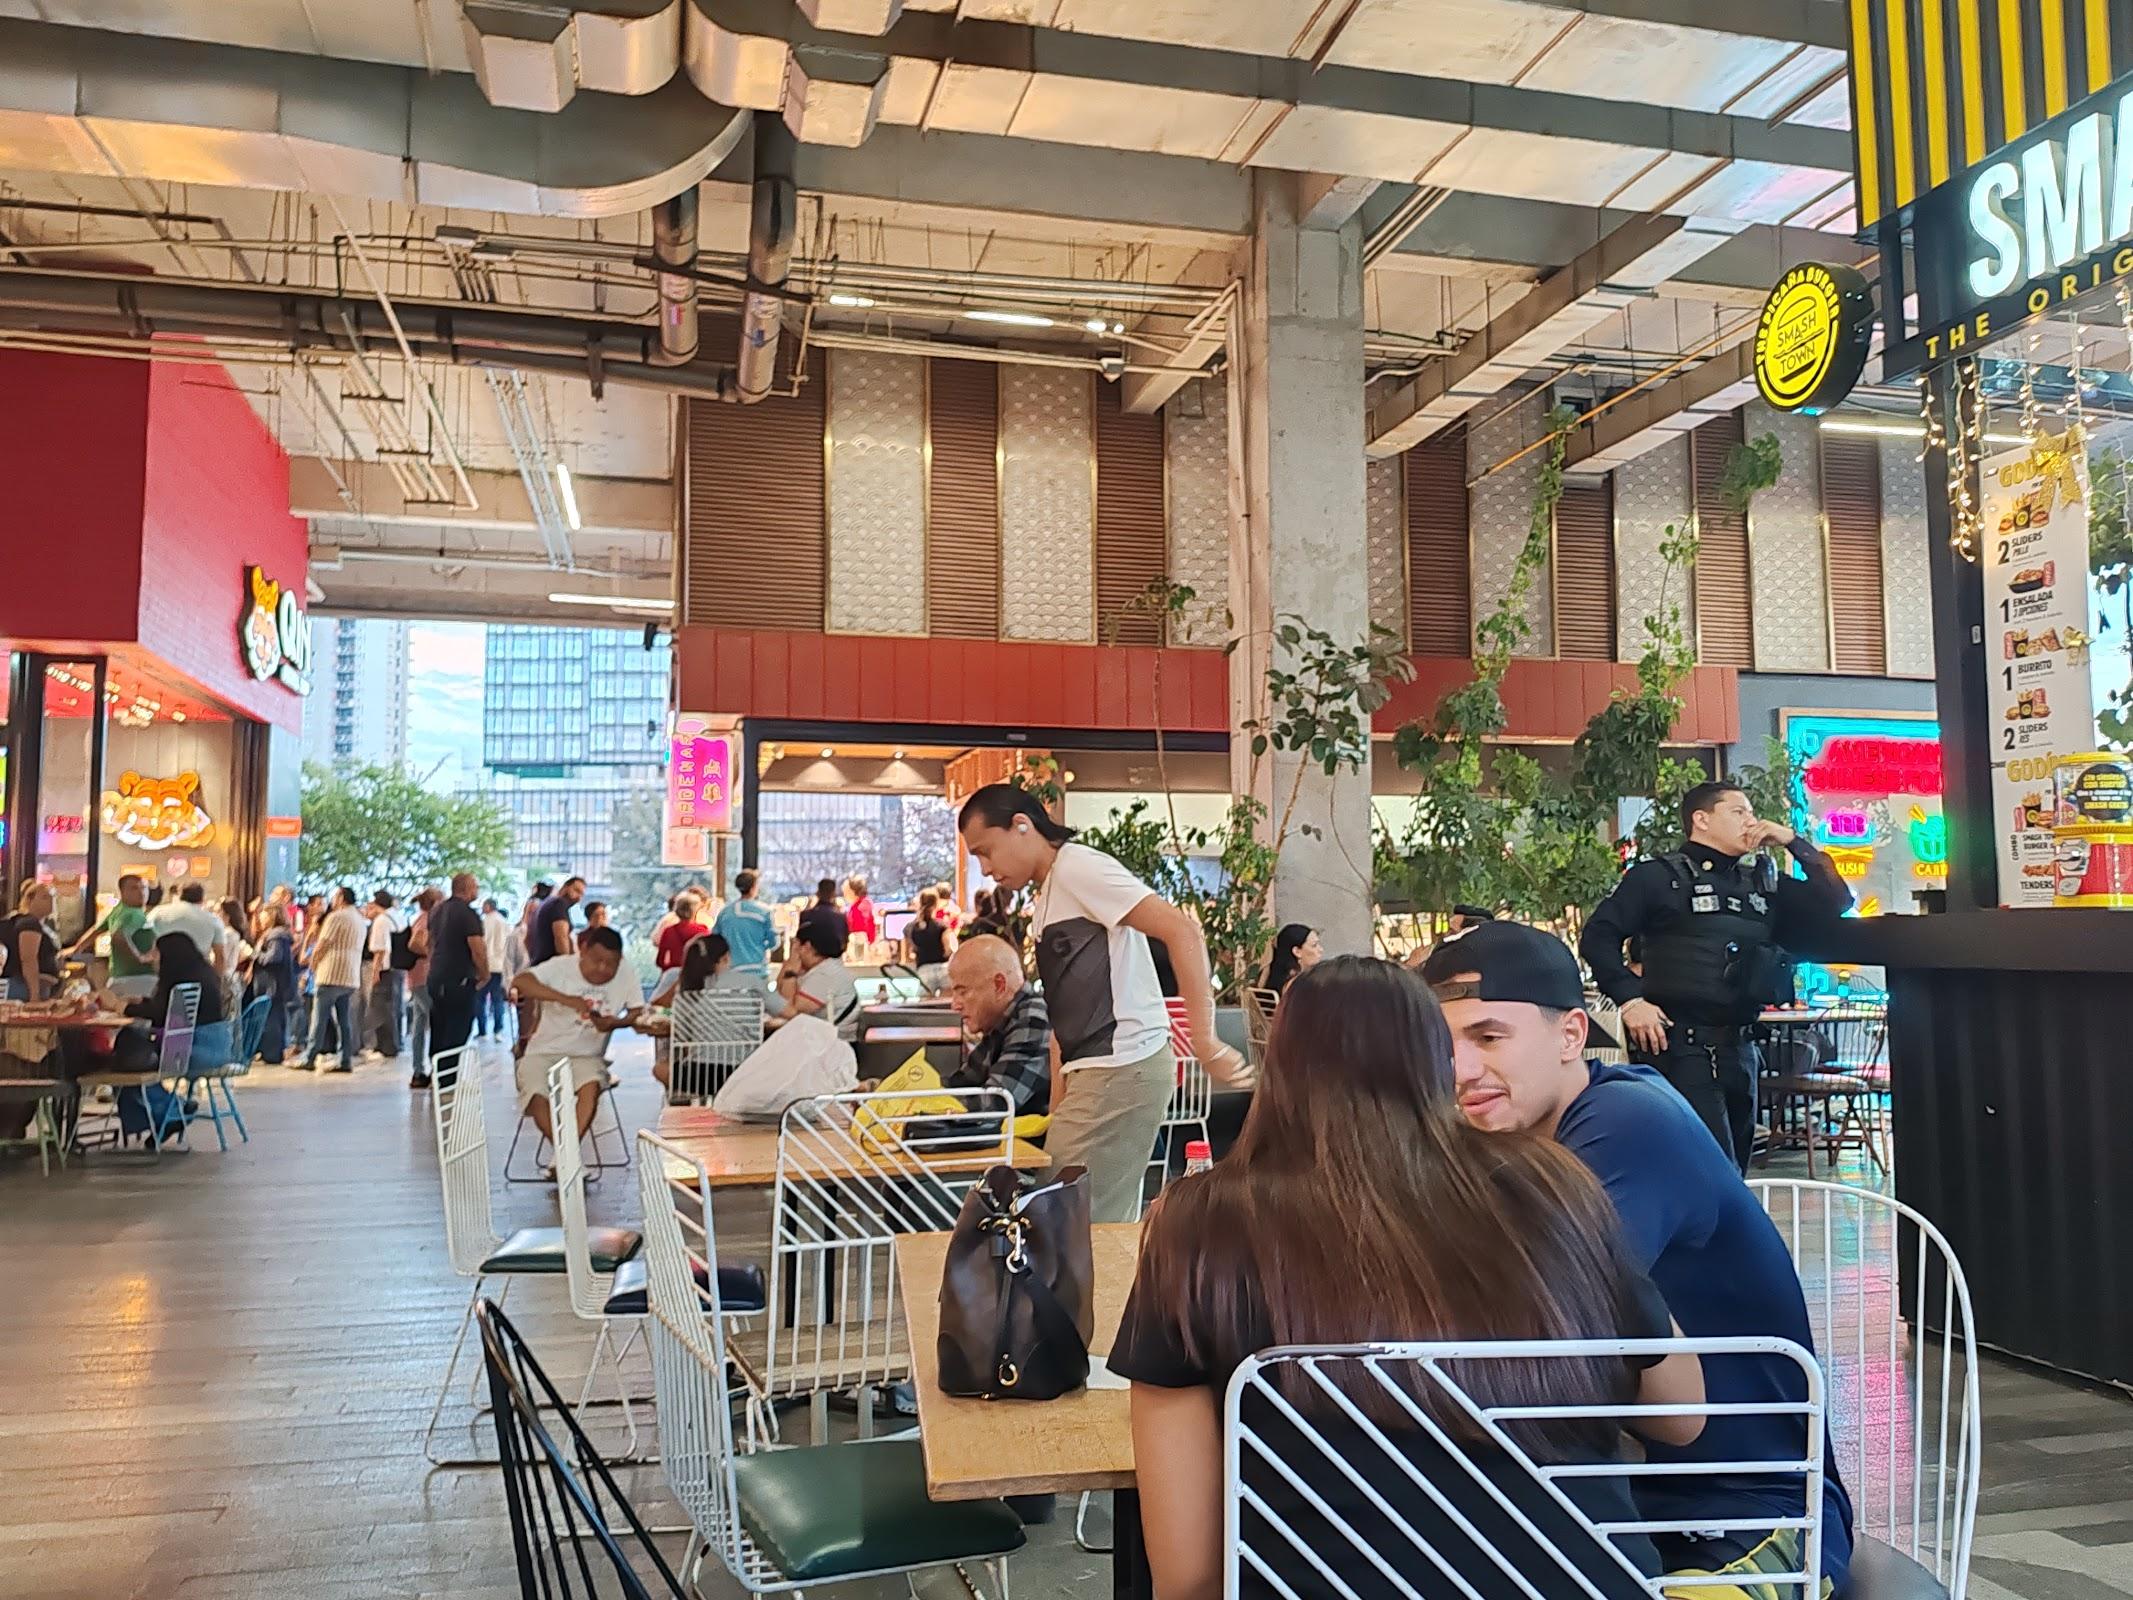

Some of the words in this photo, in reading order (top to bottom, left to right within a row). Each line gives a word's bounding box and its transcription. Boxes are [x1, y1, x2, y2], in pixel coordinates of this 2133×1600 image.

[1805, 266, 1840, 319] BURGER
[1926, 313, 1990, 359] THE
[2028, 249, 2133, 312] ORIG
[1777, 310, 1817, 348] SMASH
[1780, 342, 1816, 374] TOWN
[1999, 456, 2039, 487] GOD
[1997, 540, 2010, 565] 2
[2011, 531, 2043, 547] SLIDERS
[1999, 598, 2009, 623] 1
[2013, 591, 2053, 608] ENSALADA
[2002, 666, 2012, 691] 1
[2018, 660, 2052, 674] BURRITO
[2004, 728, 2015, 750] 2
[2018, 721, 2048, 735] SLIDERS
[2010, 834, 2019, 861] COMBO
[2024, 842, 2048, 850] BURGER
[2020, 881, 2054, 890] TENDERS
